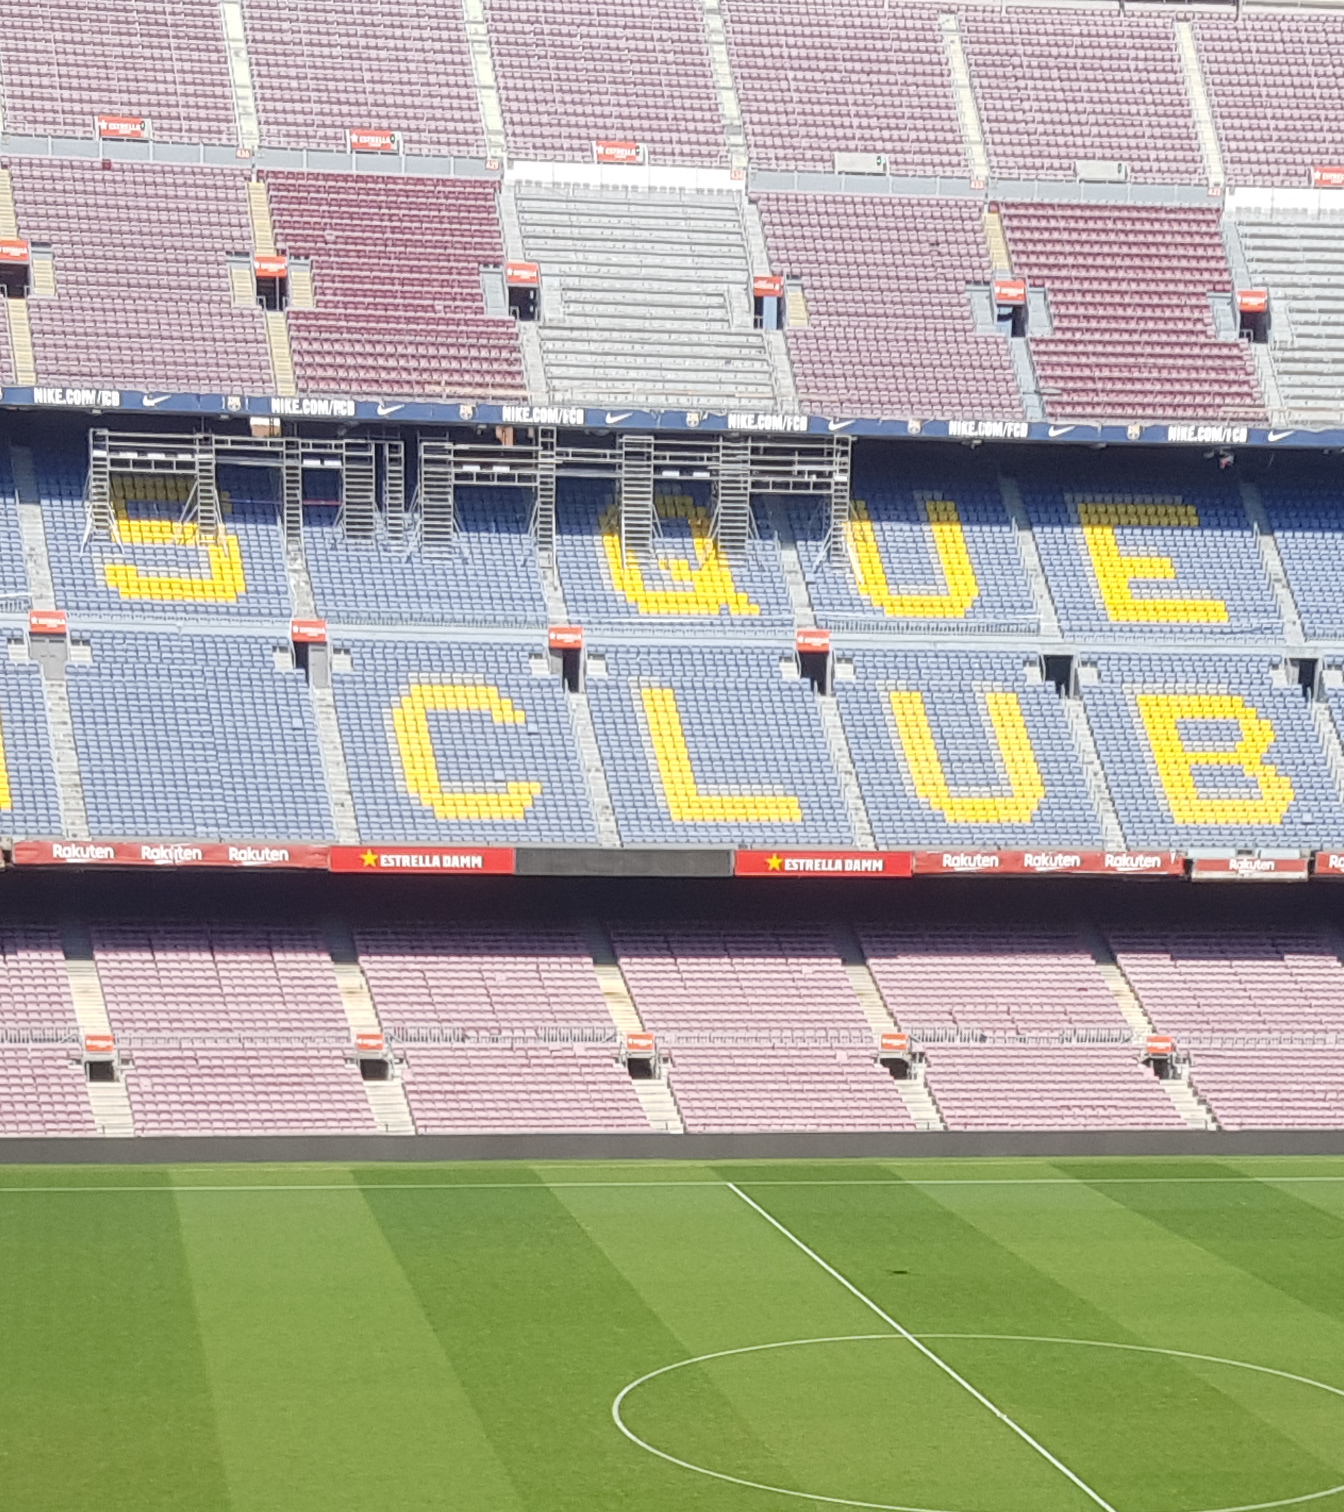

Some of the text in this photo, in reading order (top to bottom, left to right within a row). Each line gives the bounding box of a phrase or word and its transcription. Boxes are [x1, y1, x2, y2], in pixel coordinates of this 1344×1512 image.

[271, 398, 355, 416] NIKE.COM/FCB
[501, 406, 584, 425] NIKE.COM/FCB
[727, 414, 808, 431] NIKE.COM/FCB
[948, 420, 1028, 437] NIKE.COM/FCB
[602, 492, 1229, 622] QUE
[391, 684, 1294, 825] CLUB
[53, 844, 115, 859] Rakuten
[229, 847, 289, 862] Rakuten
[380, 854, 482, 868] ESTRELLA DAMM
[784, 858, 883, 871] ESTRELLA DAMM
[942, 853, 999, 867] Rakuten
[1024, 854, 1080, 868] Rakuten
[1106, 855, 1161, 869] Rakuten
[1229, 858, 1274, 872] Rakuten
